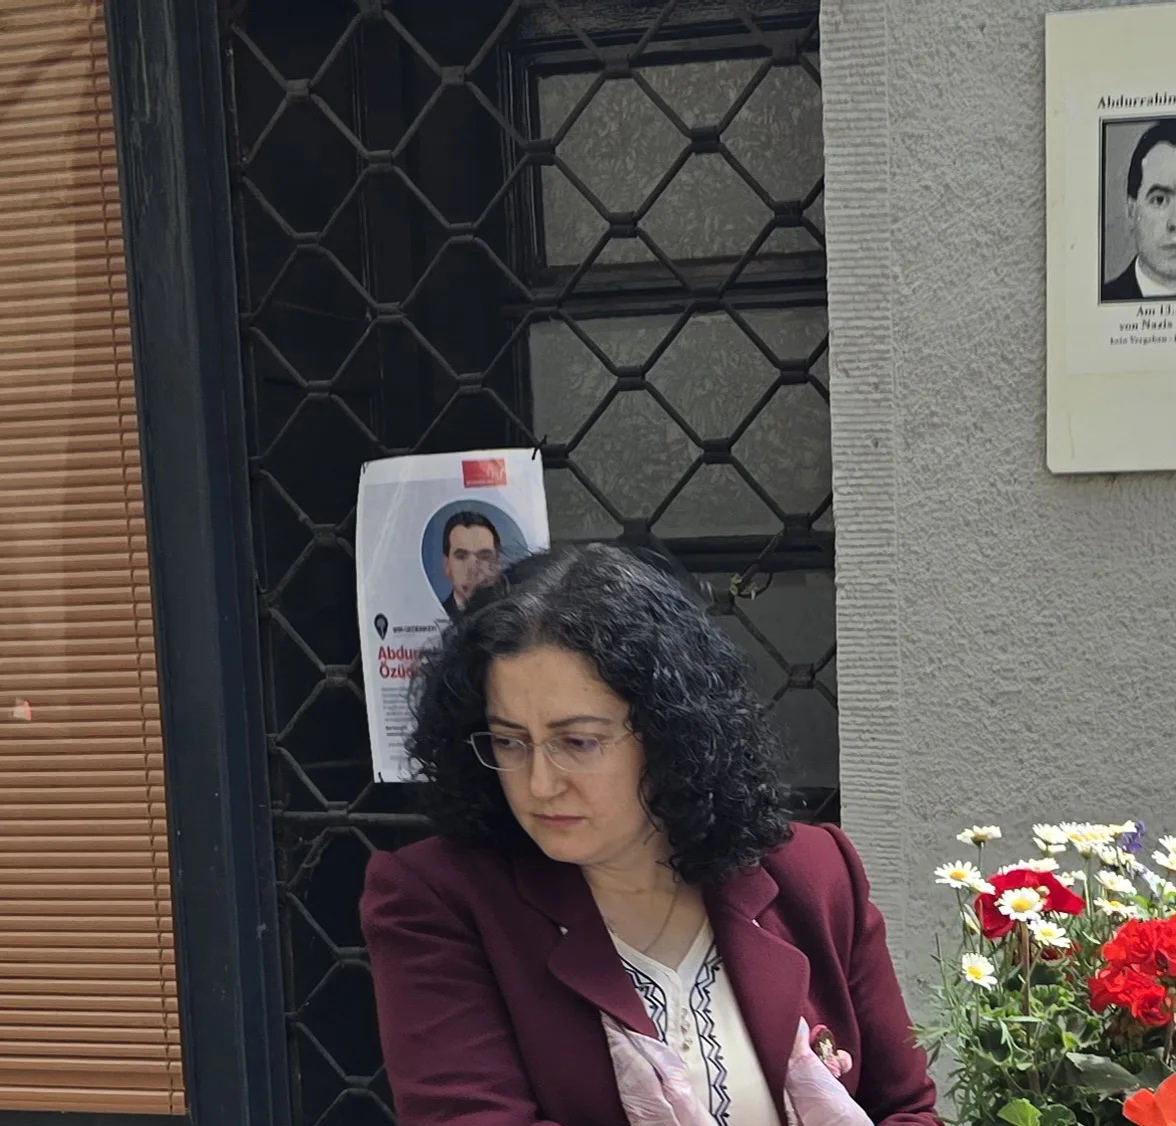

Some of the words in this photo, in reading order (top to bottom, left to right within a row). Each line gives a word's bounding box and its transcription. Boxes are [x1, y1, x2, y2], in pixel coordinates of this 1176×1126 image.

[1137, 306, 1155, 316] Am
[1120, 321, 1138, 331] von
[1141, 319, 1172, 330] Nazis
